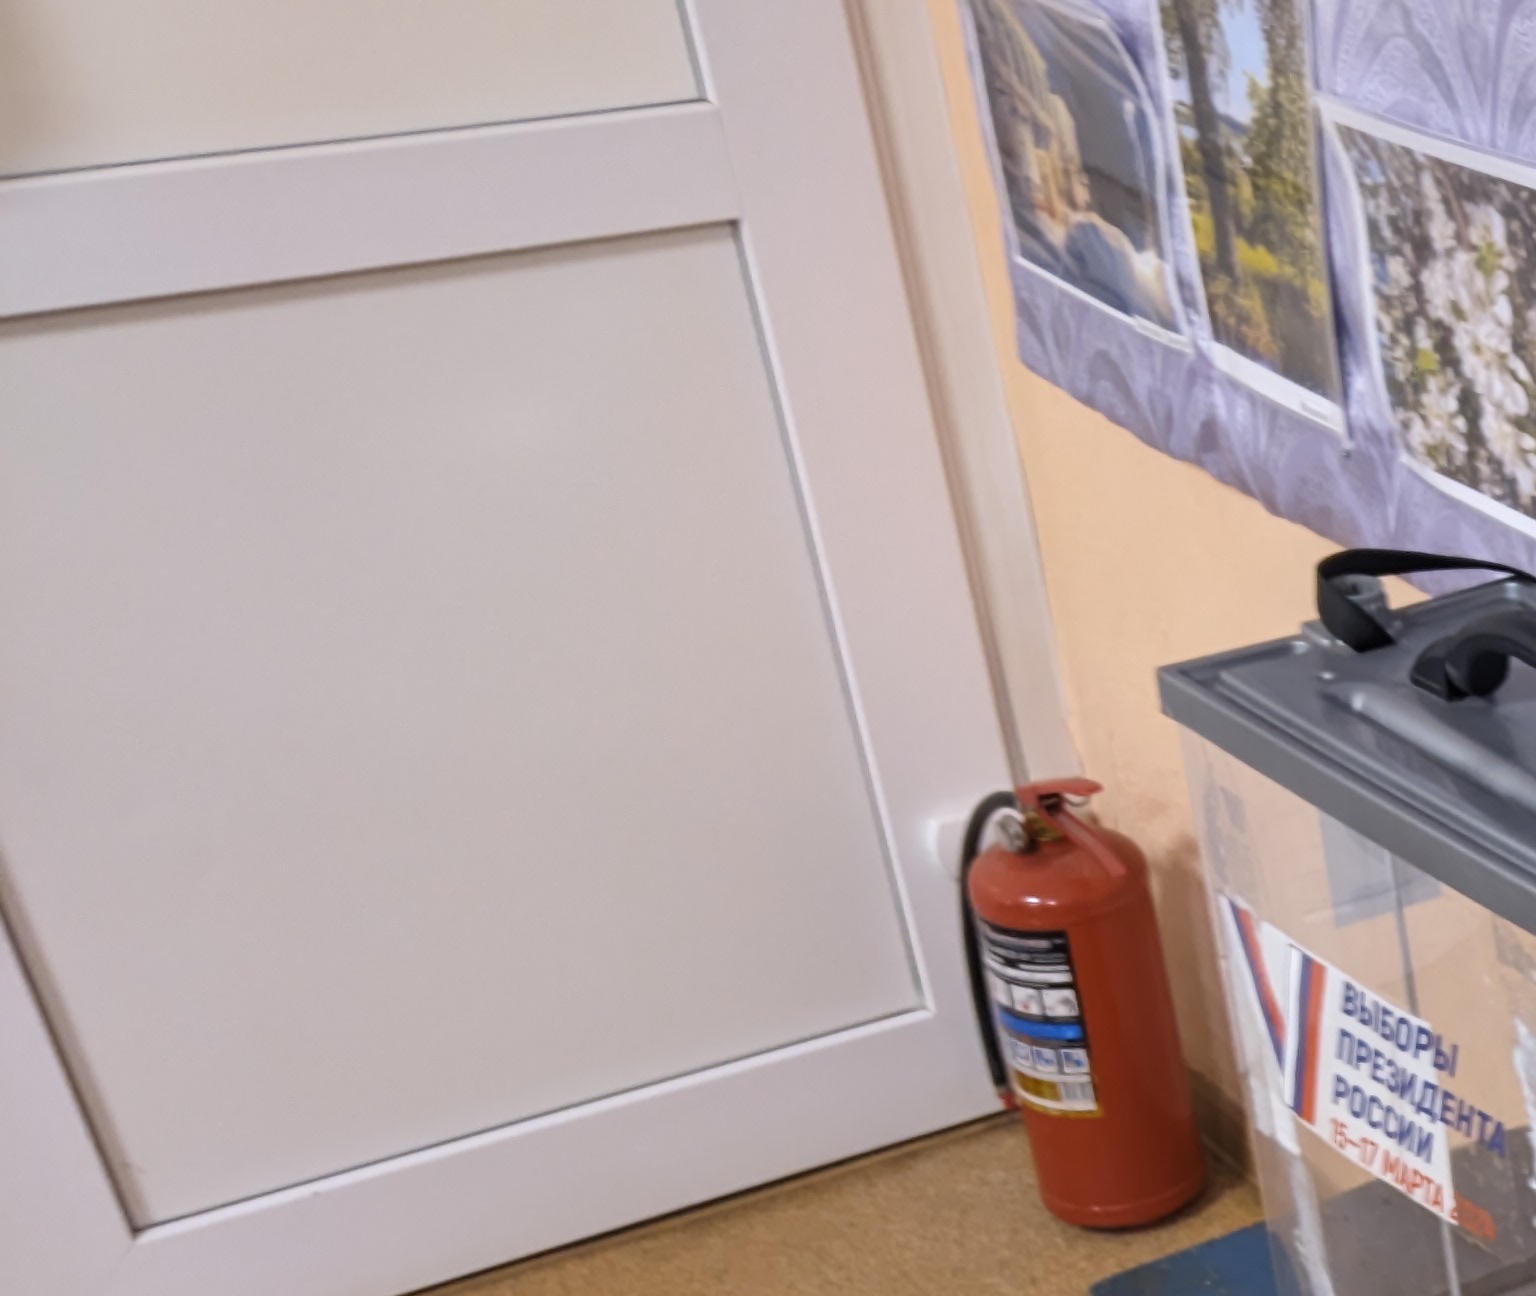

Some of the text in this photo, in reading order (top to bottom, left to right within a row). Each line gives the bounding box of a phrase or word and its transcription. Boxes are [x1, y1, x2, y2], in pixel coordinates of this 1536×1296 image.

[1341, 980, 1460, 1078] ВЫБОРЫ
[1330, 1073, 1435, 1165] РОССИИ
[1335, 1027, 1507, 1159] ПРЕЗИДЕНТА
[1381, 1150, 1446, 1214] МАРТА
